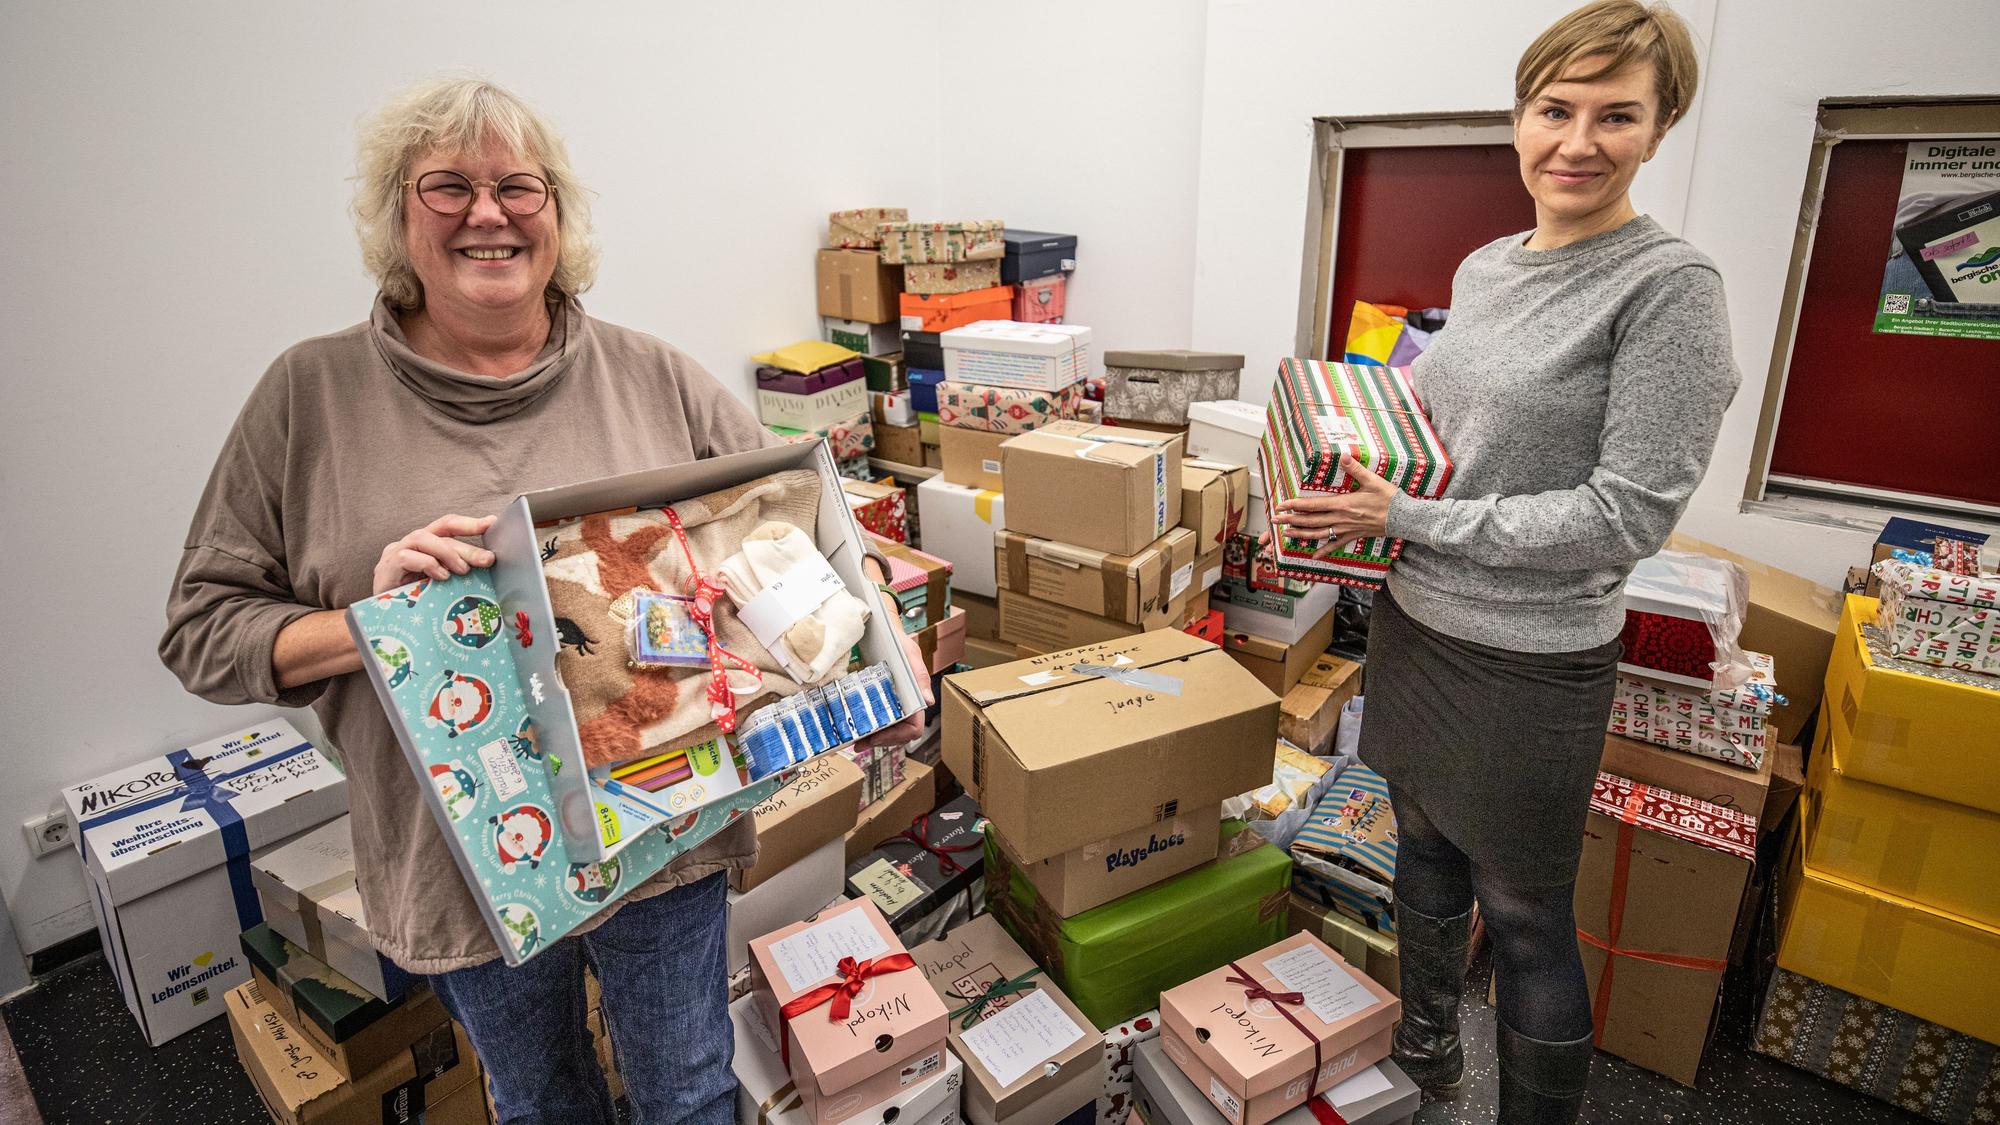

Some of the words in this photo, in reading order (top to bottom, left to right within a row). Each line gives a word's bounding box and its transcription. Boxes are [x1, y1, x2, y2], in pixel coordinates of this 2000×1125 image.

[1928, 146, 1996, 159] Digitale
[1909, 160, 1967, 170] immer
[1950, 262, 1999, 285] bergische
[763, 394, 805, 411] DIVINO
[815, 384, 863, 410] DIVINO
[1104, 693, 1156, 714] Junge
[222, 739, 241, 751] Wir
[228, 772, 261, 788] FOR
[266, 751, 314, 773] FAMILY
[286, 757, 317, 774] KIDS
[791, 767, 841, 797] UNISEX
[135, 818, 163, 834] Ihre
[598, 807, 611, 827] 8+1
[110, 820, 204, 858] überraschung
[111, 816, 194, 849] Weihnachts-
[941, 825, 966, 847] Rover
[1105, 829, 1186, 874] Playshoes
[513, 888, 546, 911] Christmas
[151, 957, 239, 1005] Lebensmittel.
[167, 964, 191, 982] Wir
[846, 992, 912, 1037] Nikopol
[1210, 1002, 1284, 1058] Nikopol
[283, 1043, 313, 1070] Junge
[1285, 1050, 1359, 1101] Graeland
[399, 1086, 409, 1125] amazon
